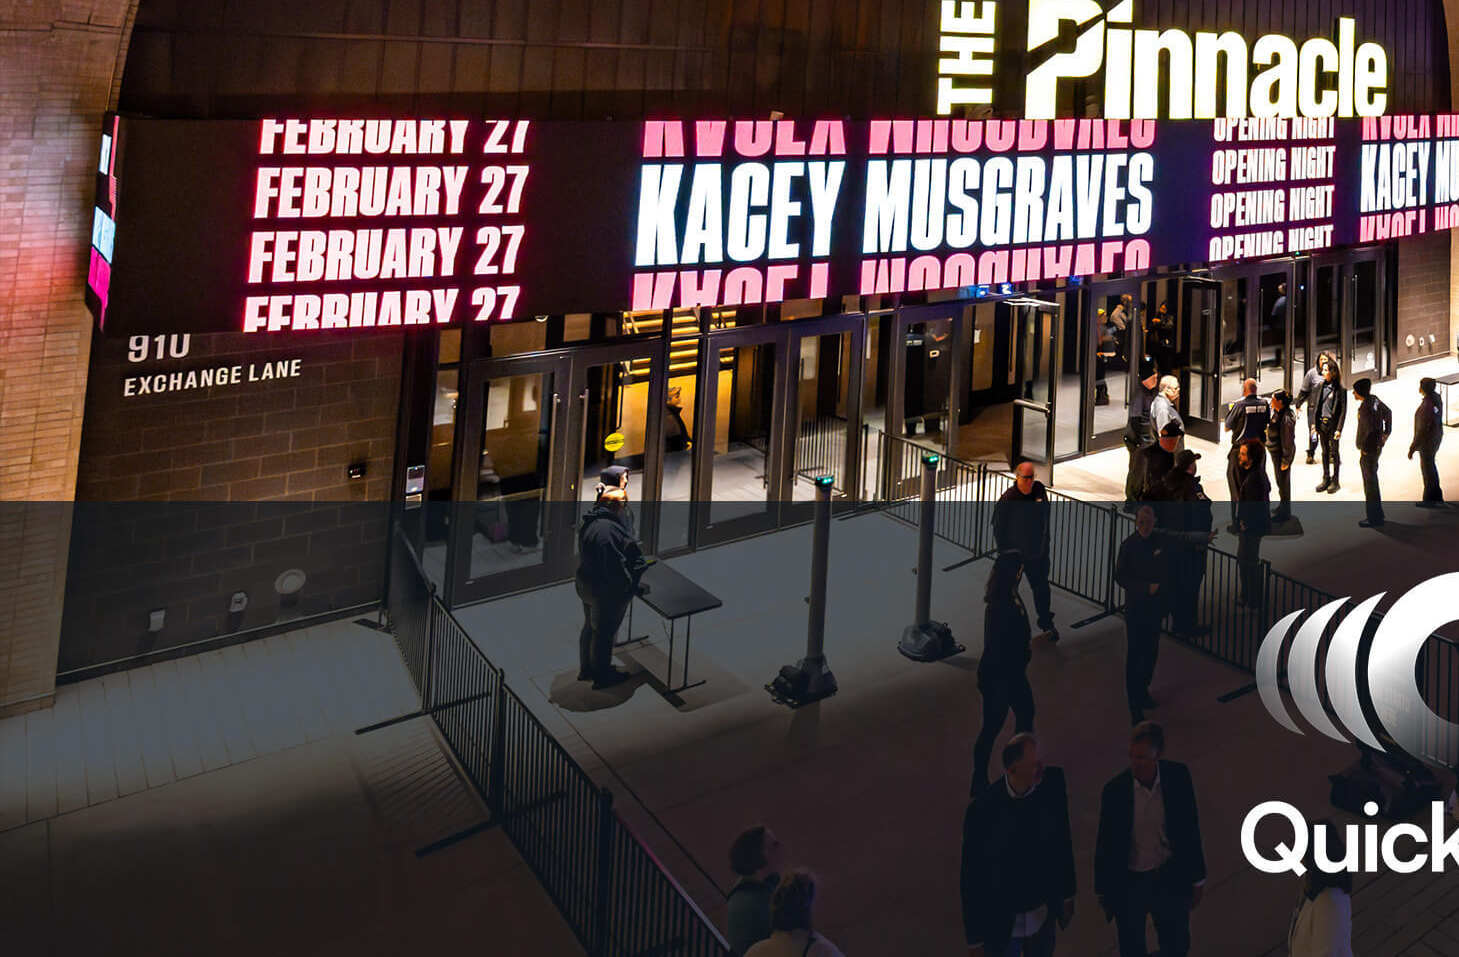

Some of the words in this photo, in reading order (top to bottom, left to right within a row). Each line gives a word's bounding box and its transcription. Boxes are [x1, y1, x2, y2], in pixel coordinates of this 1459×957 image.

[937, 0, 996, 115] THE
[254, 166, 469, 218] FEBRUARY
[478, 165, 530, 213] 27
[1212, 148, 1287, 185] OPENING
[1290, 146, 1336, 181] NIGHT
[1360, 141, 1431, 213] KACEY
[635, 161, 846, 266] KACEY
[862, 152, 1154, 254] MUSGRAVES
[1210, 189, 1285, 229] OPENING
[1289, 185, 1335, 221] NIGHT
[248, 226, 463, 283] FEBRUARY
[474, 225, 524, 275] 27
[124, 366, 242, 397] EXCHANGE
[248, 359, 302, 382] LANE
